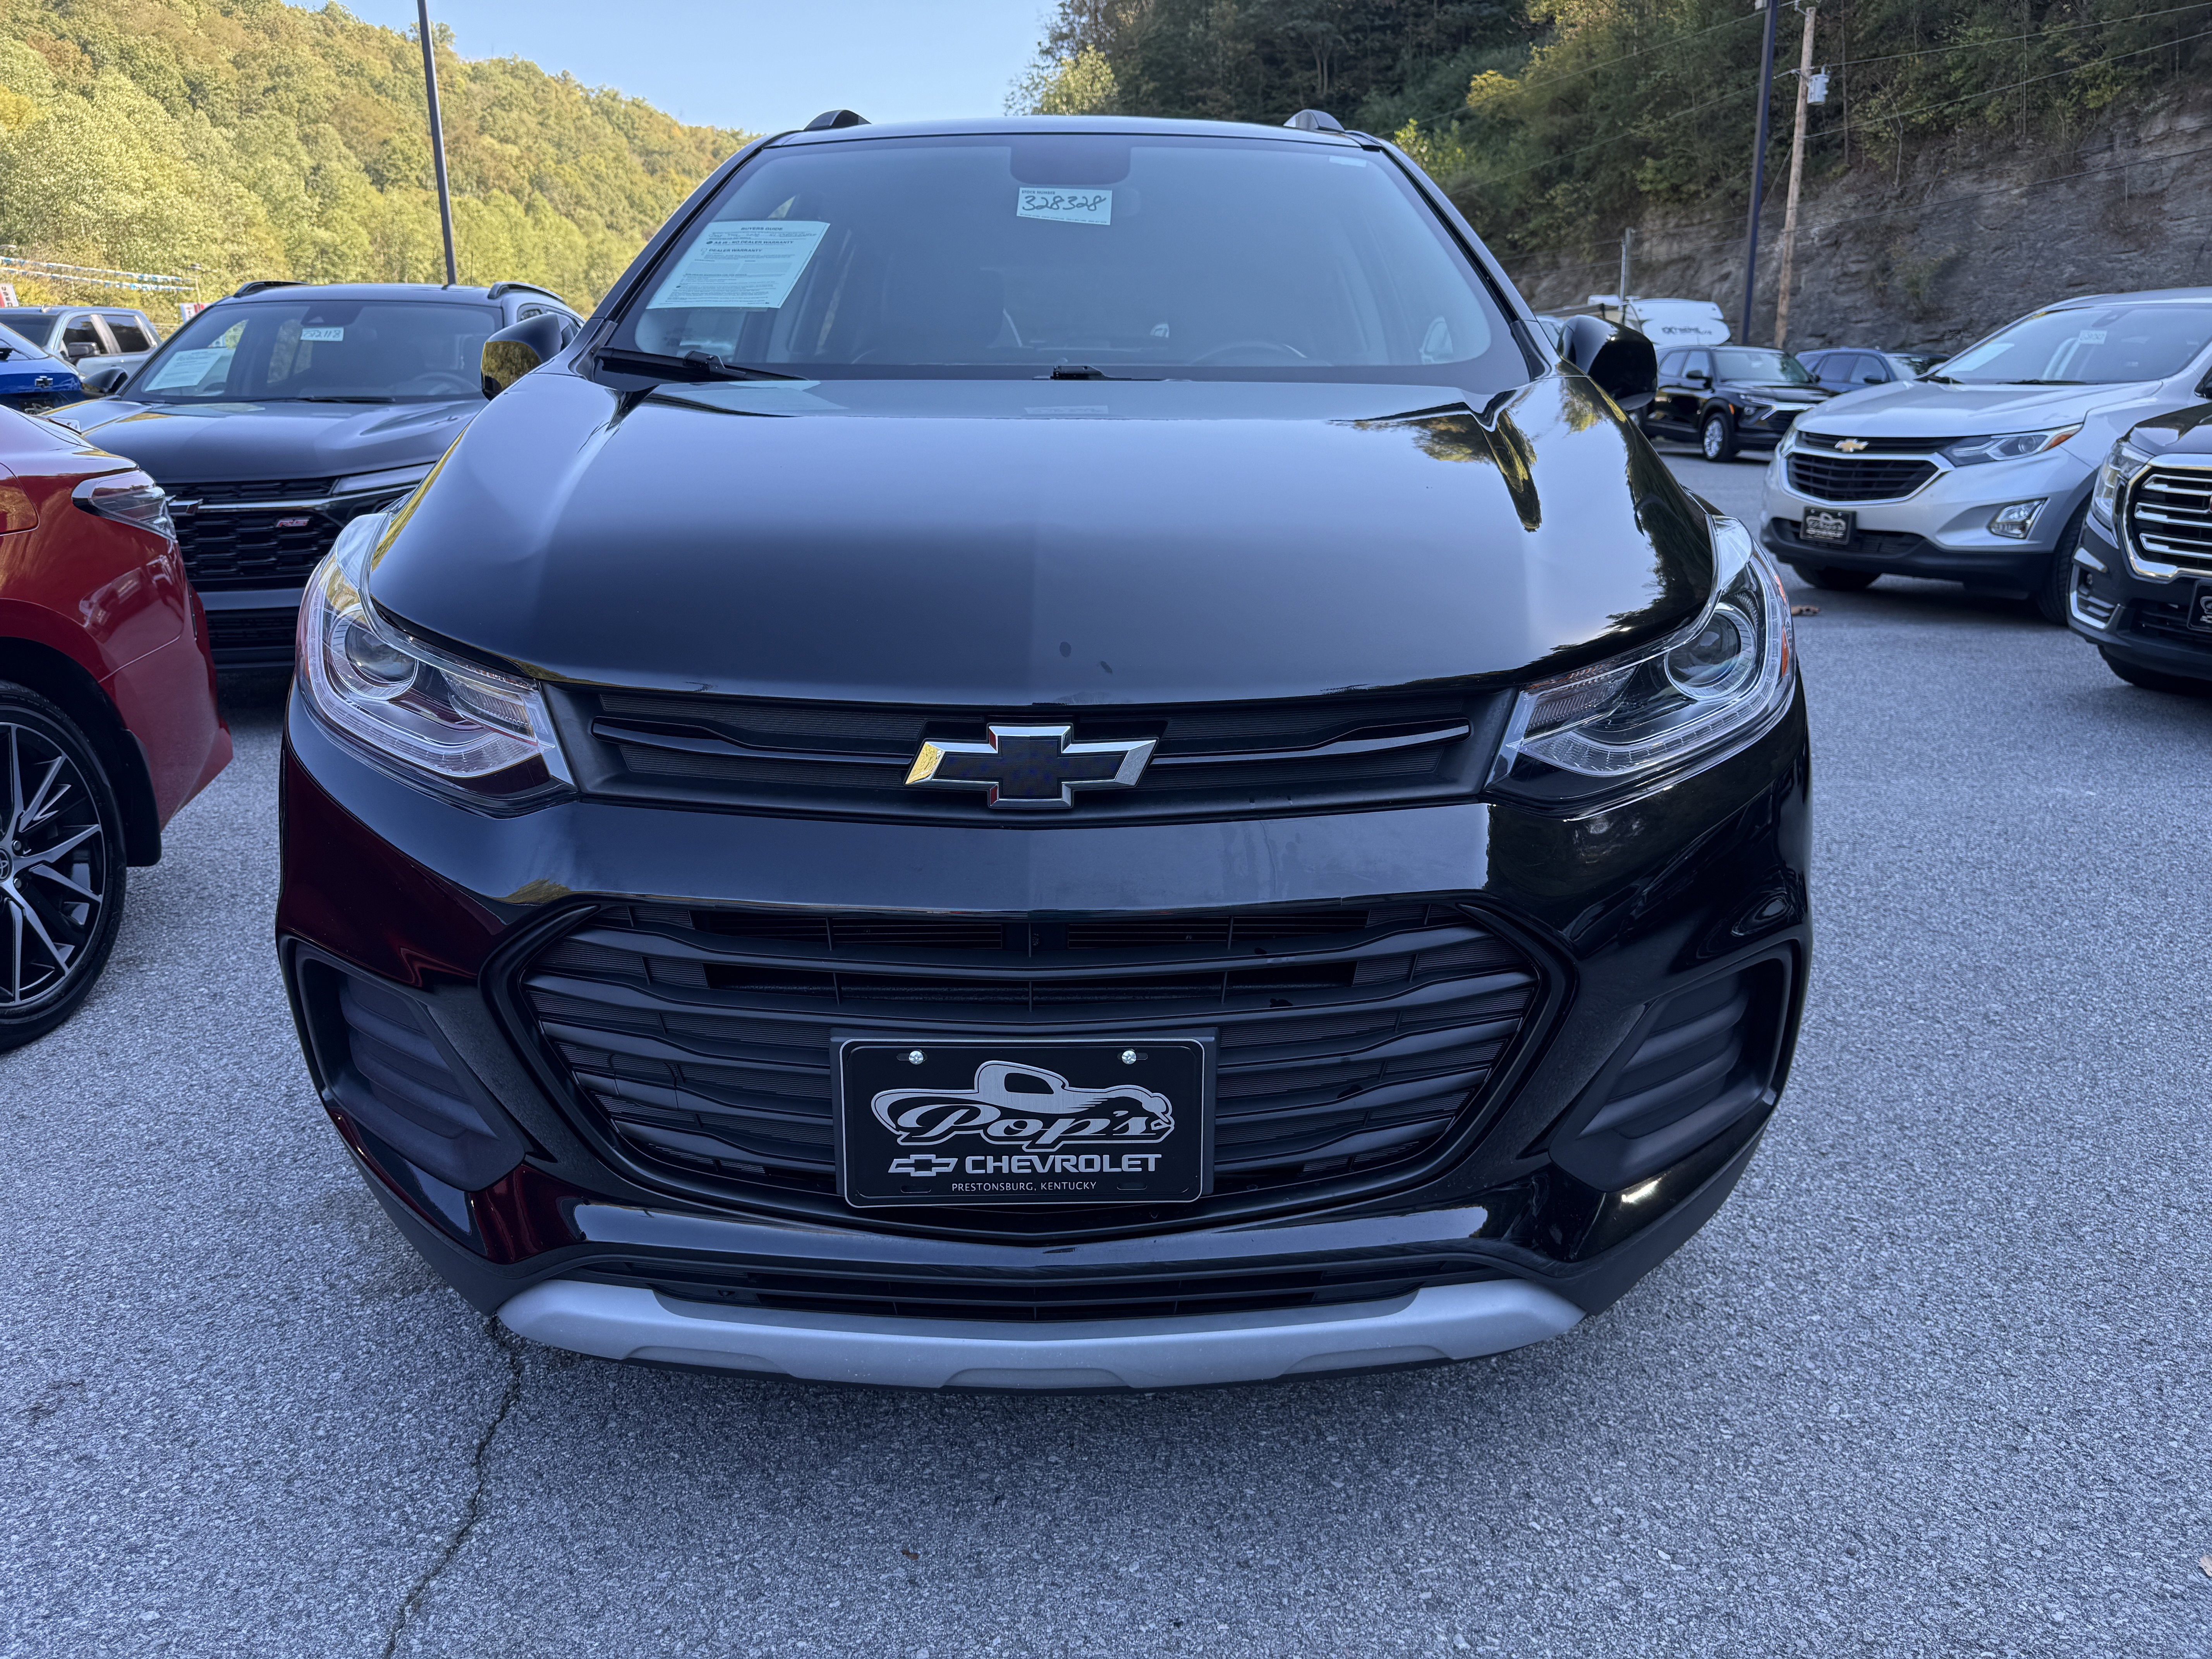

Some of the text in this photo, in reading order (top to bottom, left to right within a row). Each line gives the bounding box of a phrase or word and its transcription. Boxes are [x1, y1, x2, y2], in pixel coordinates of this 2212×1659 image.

[1022, 195, 1107, 211] 328328
[276, 518, 309, 527] RS
[897, 1104, 1157, 1144] Pop's
[965, 1154, 1162, 1174] CHEVROLET
[951, 1182, 1097, 1192] PRESTONSBURG, KENTUCKY
